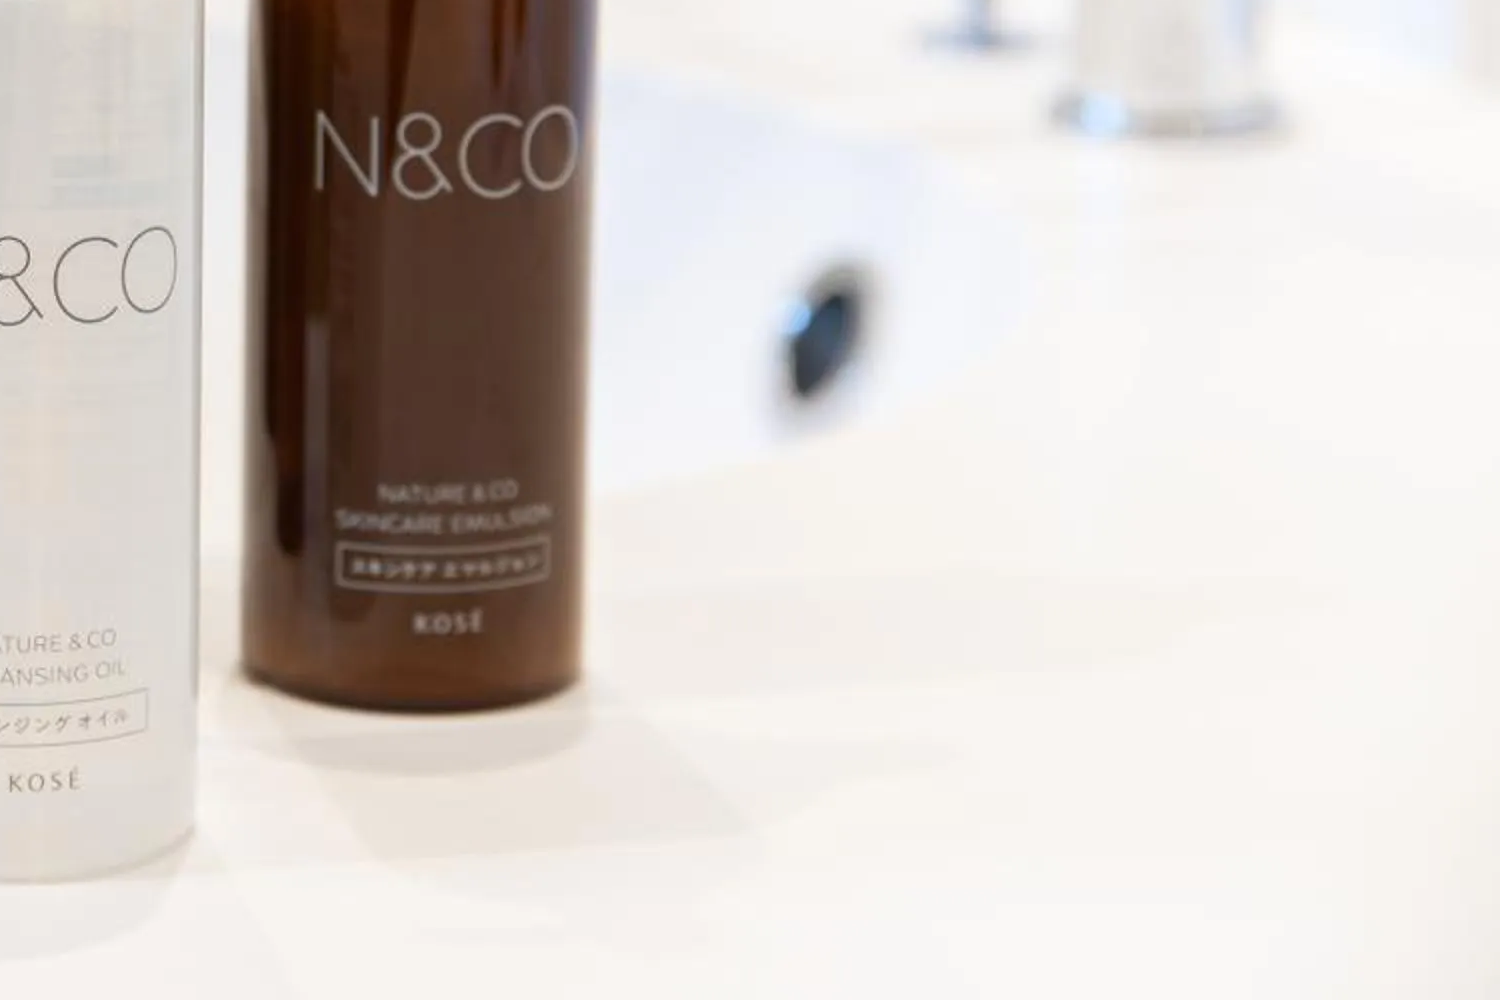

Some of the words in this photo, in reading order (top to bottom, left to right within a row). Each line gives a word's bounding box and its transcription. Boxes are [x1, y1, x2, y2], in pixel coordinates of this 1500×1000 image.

[315, 104, 579, 200] N&CO
[377, 483, 466, 505] NATURE
[334, 507, 443, 535] SKINCARE
[95, 659, 127, 680] OIL
[8, 765, 82, 793] KOSÉ
